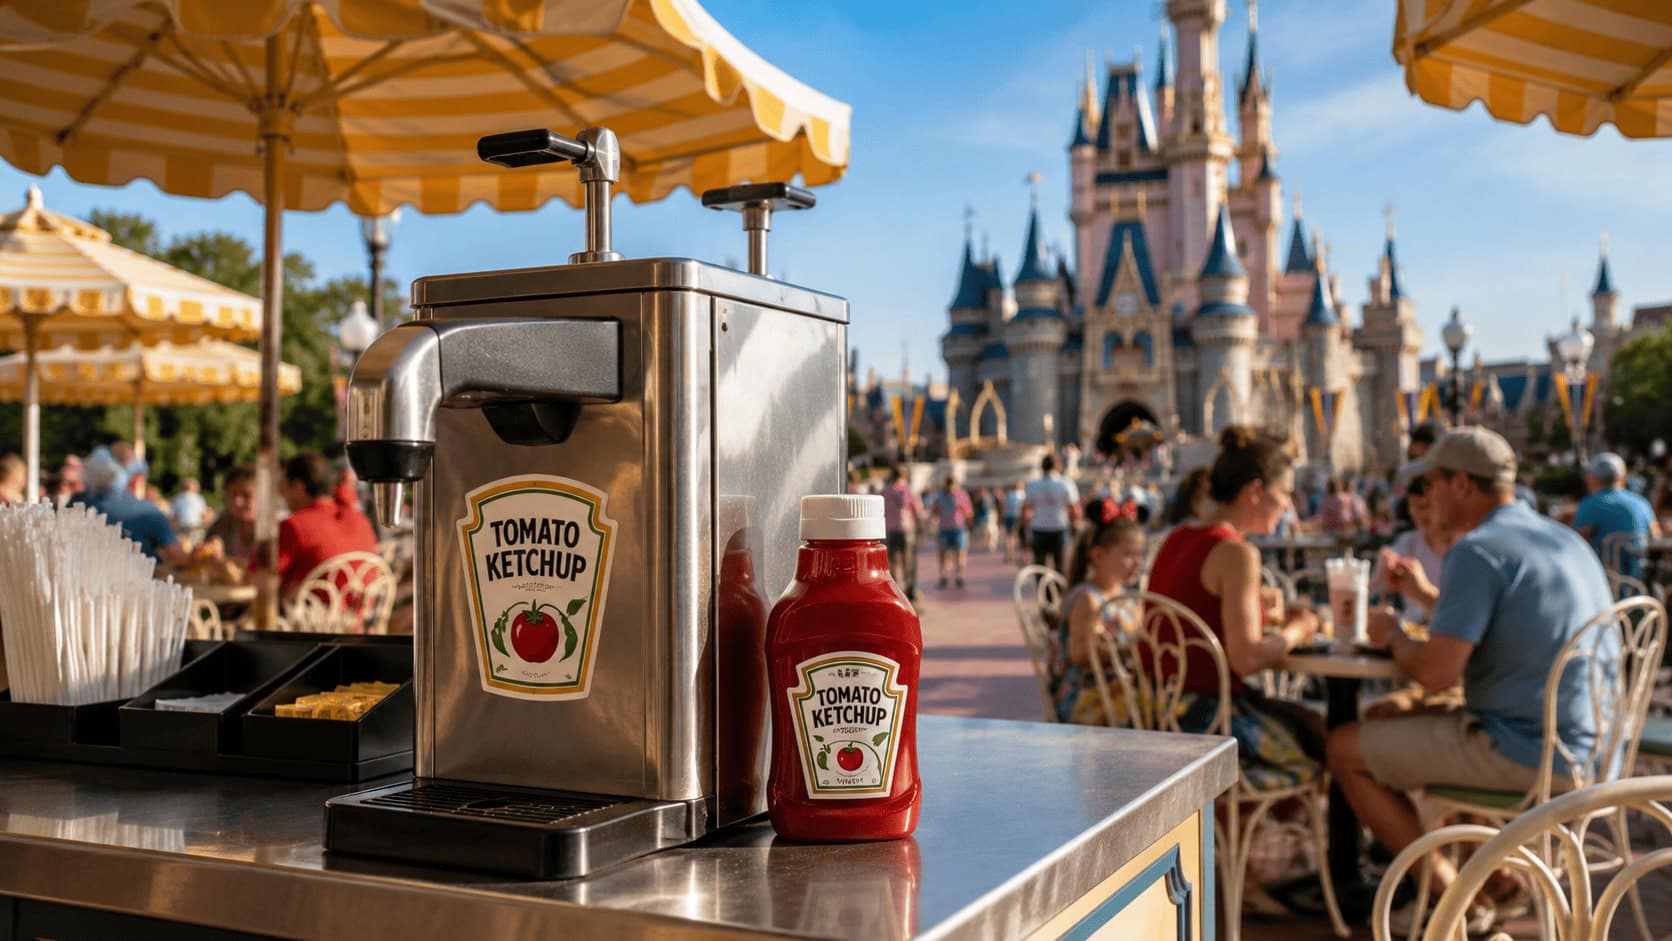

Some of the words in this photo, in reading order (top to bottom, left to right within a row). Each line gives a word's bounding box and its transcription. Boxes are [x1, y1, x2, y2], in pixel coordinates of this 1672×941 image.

[490, 518, 580, 548] TOMATO
[486, 548, 587, 582] KETCHUP
[816, 686, 882, 706] TOMATO
[811, 705, 887, 728] KETCHUP
